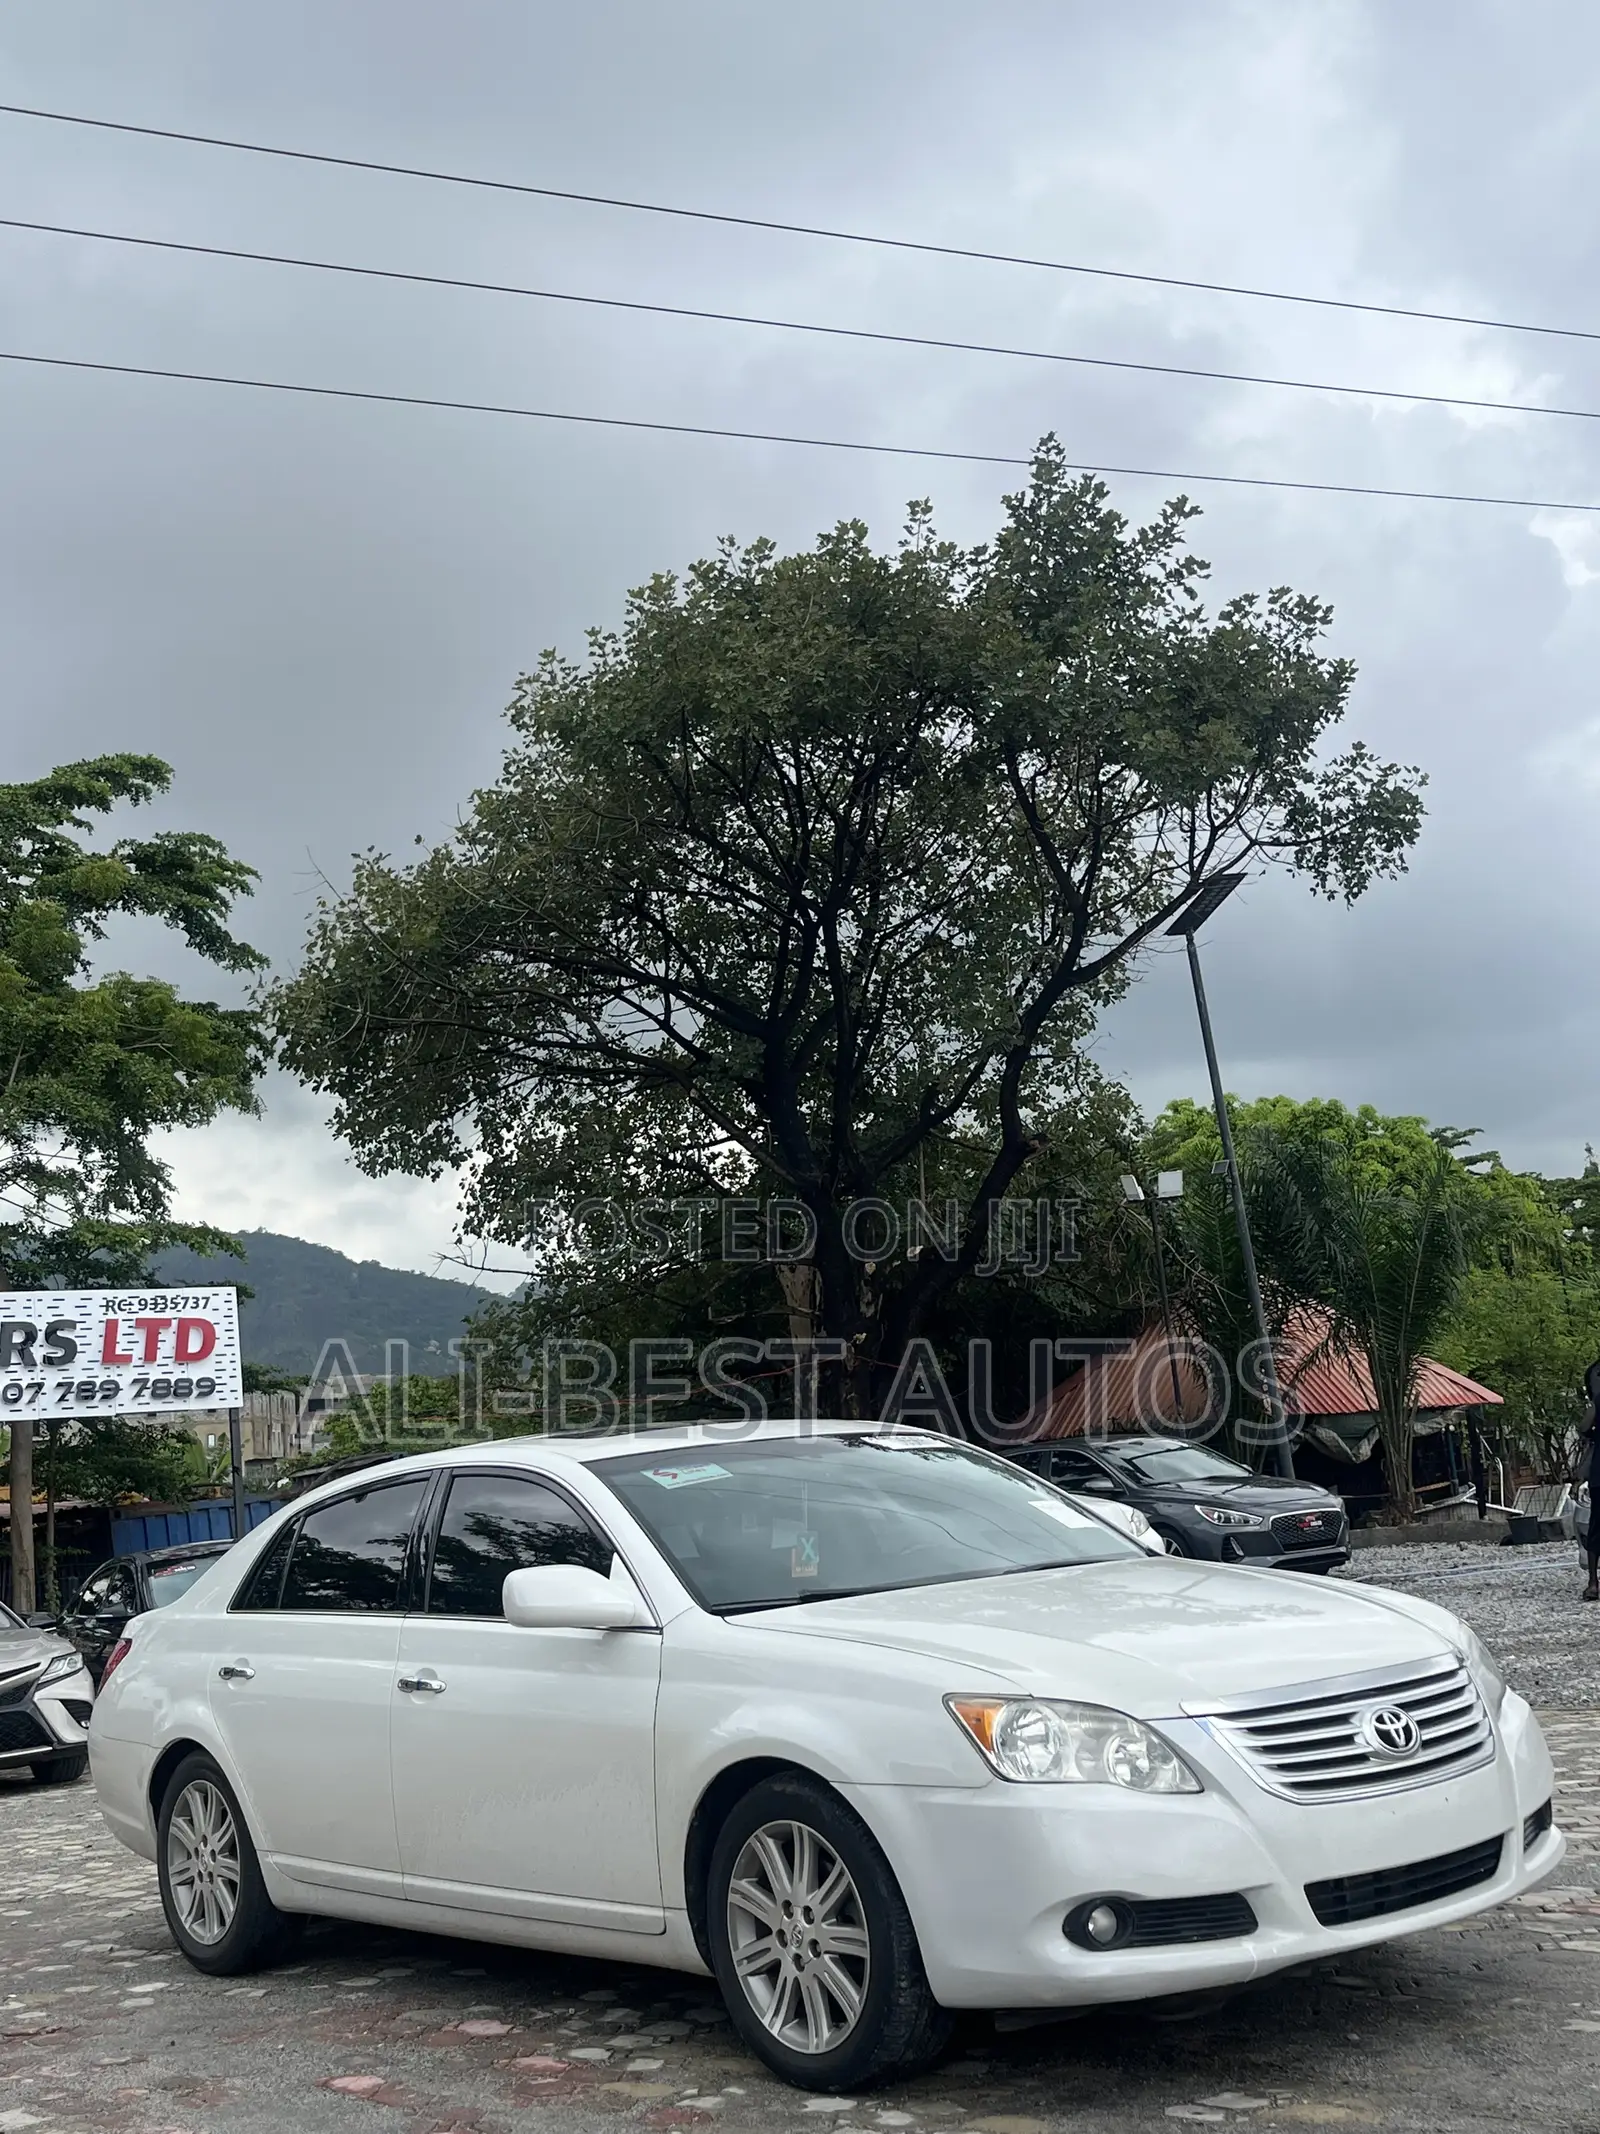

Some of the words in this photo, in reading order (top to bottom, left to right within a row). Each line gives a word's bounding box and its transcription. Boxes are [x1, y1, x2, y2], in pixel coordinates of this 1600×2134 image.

[0, 1319, 78, 1367] RS
[100, 1317, 217, 1365] LTD
[54, 1379, 121, 1404] 789
[129, 1376, 217, 1399] 7889
